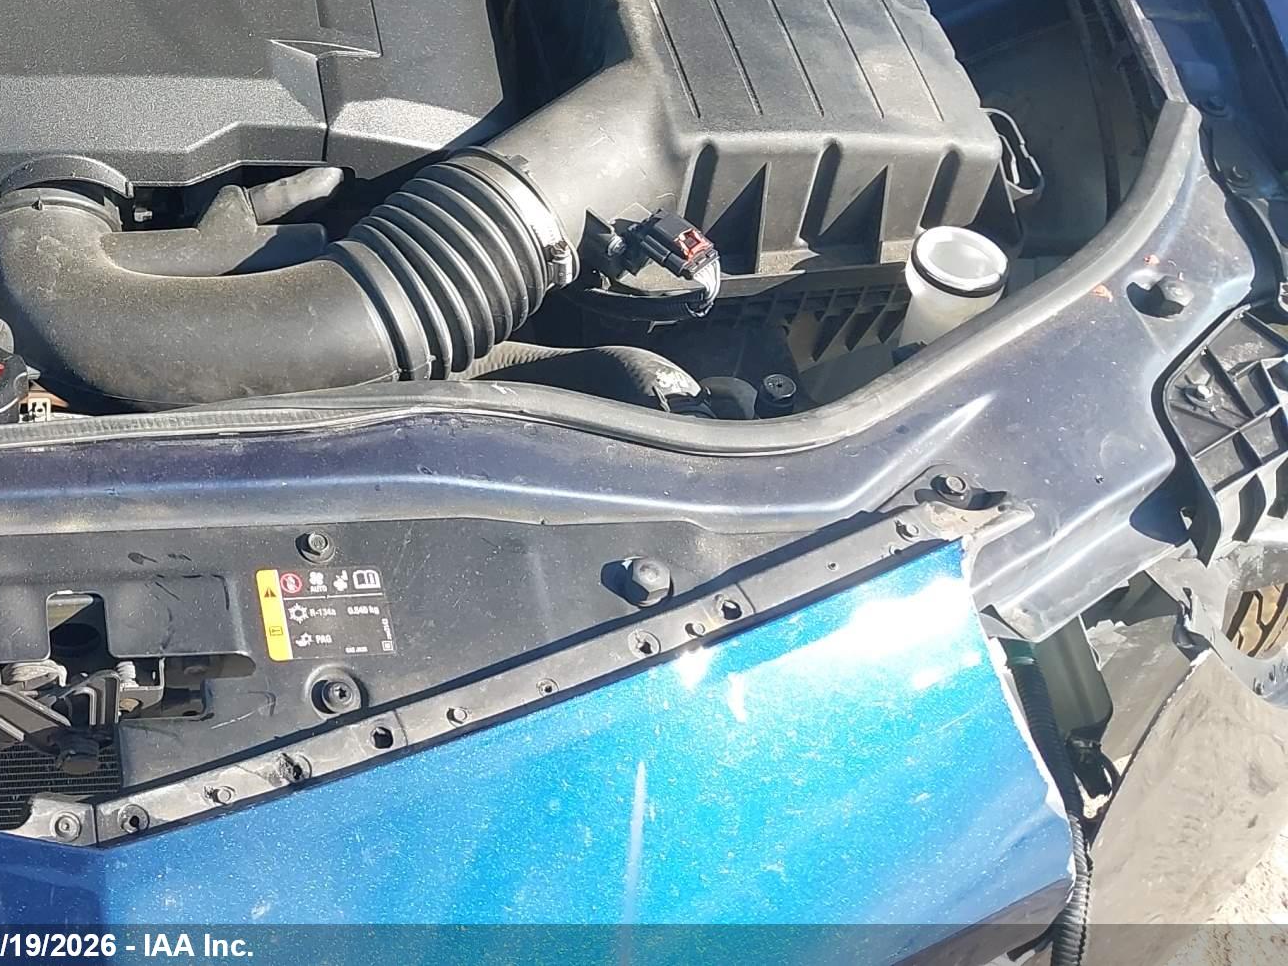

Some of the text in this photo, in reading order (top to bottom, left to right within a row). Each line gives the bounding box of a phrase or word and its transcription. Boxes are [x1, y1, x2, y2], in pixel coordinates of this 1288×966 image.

[310, 585, 328, 593] AUTO
[309, 607, 337, 617] R-134a
[368, 604, 380, 615] kg
[315, 634, 332, 644] PAG
